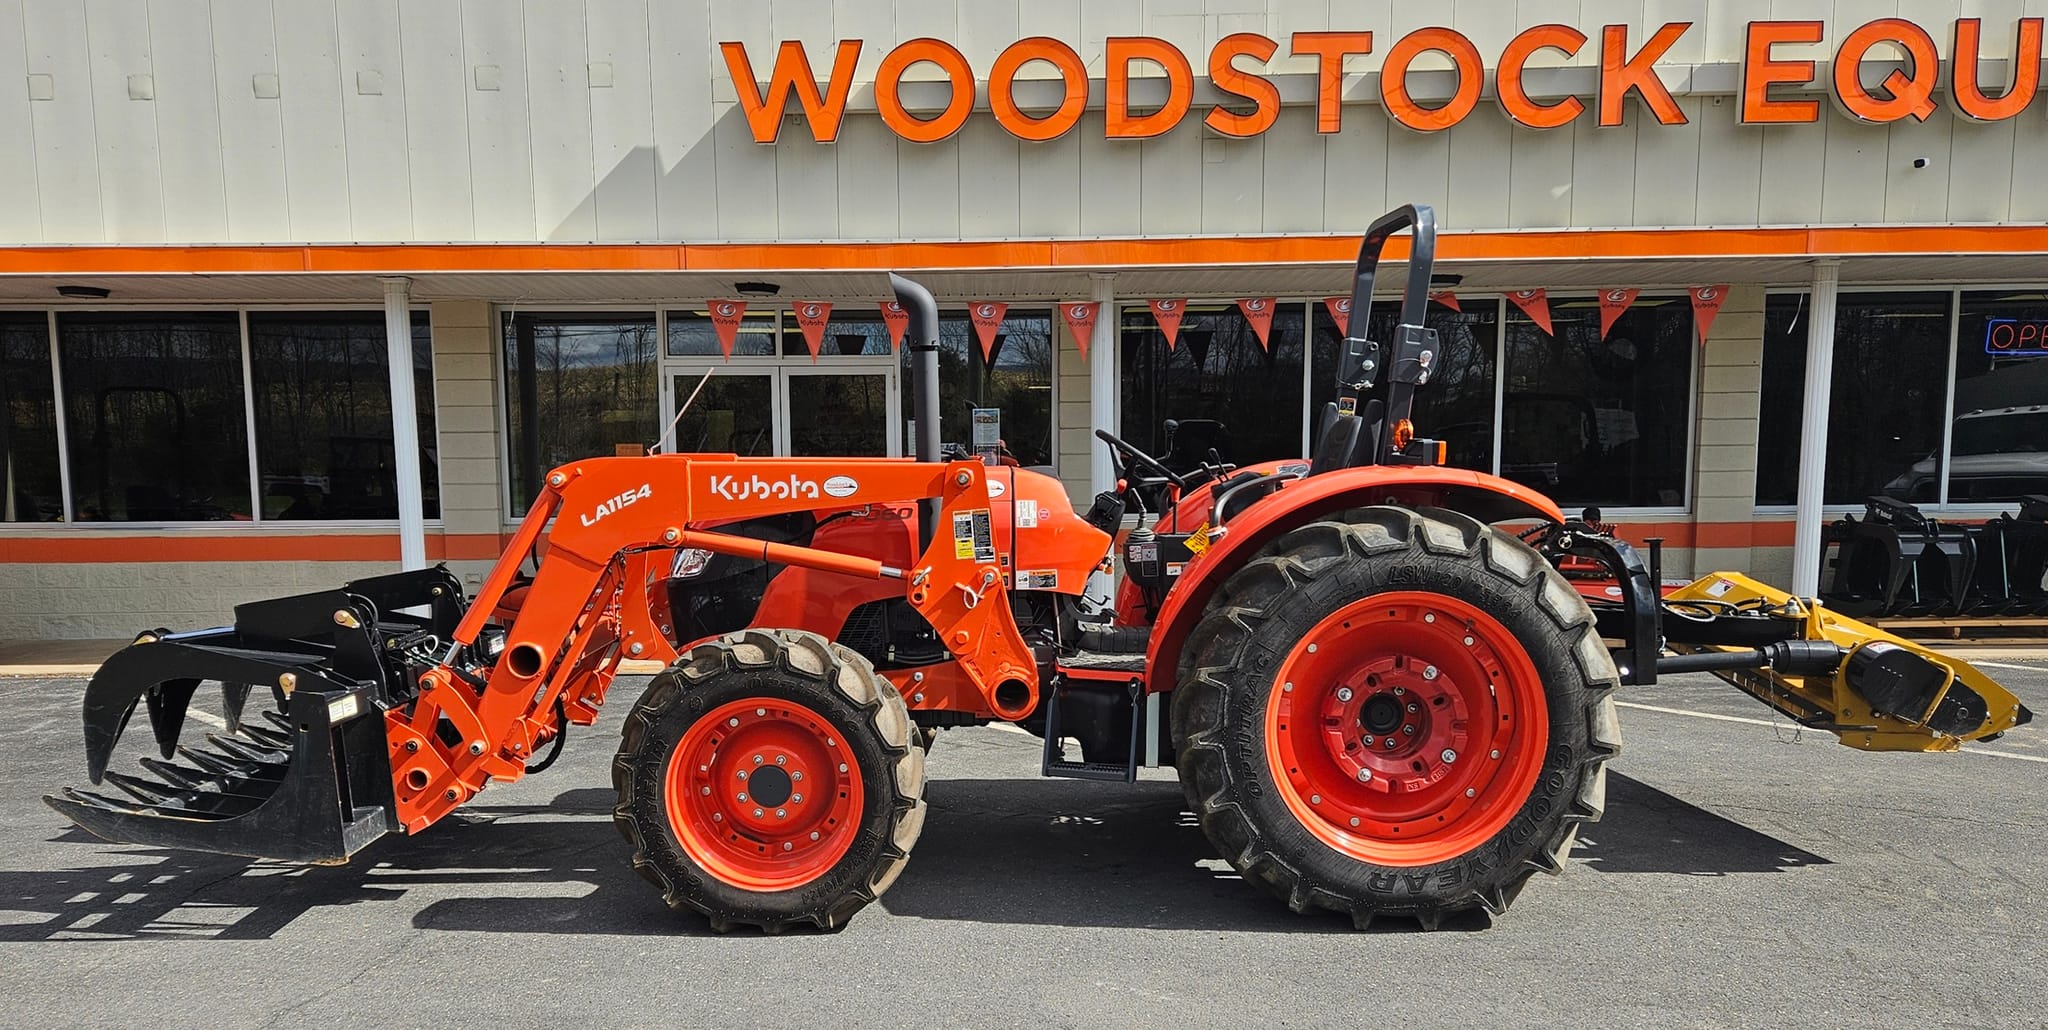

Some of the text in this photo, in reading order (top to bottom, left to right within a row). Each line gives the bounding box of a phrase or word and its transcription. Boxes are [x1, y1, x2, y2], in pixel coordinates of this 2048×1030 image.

[718, 21, 1691, 145] WOODSTOCK
[580, 483, 652, 527] LA1154
[710, 474, 819, 500] Kubota
[1366, 743, 1573, 895] GOODYEAR
